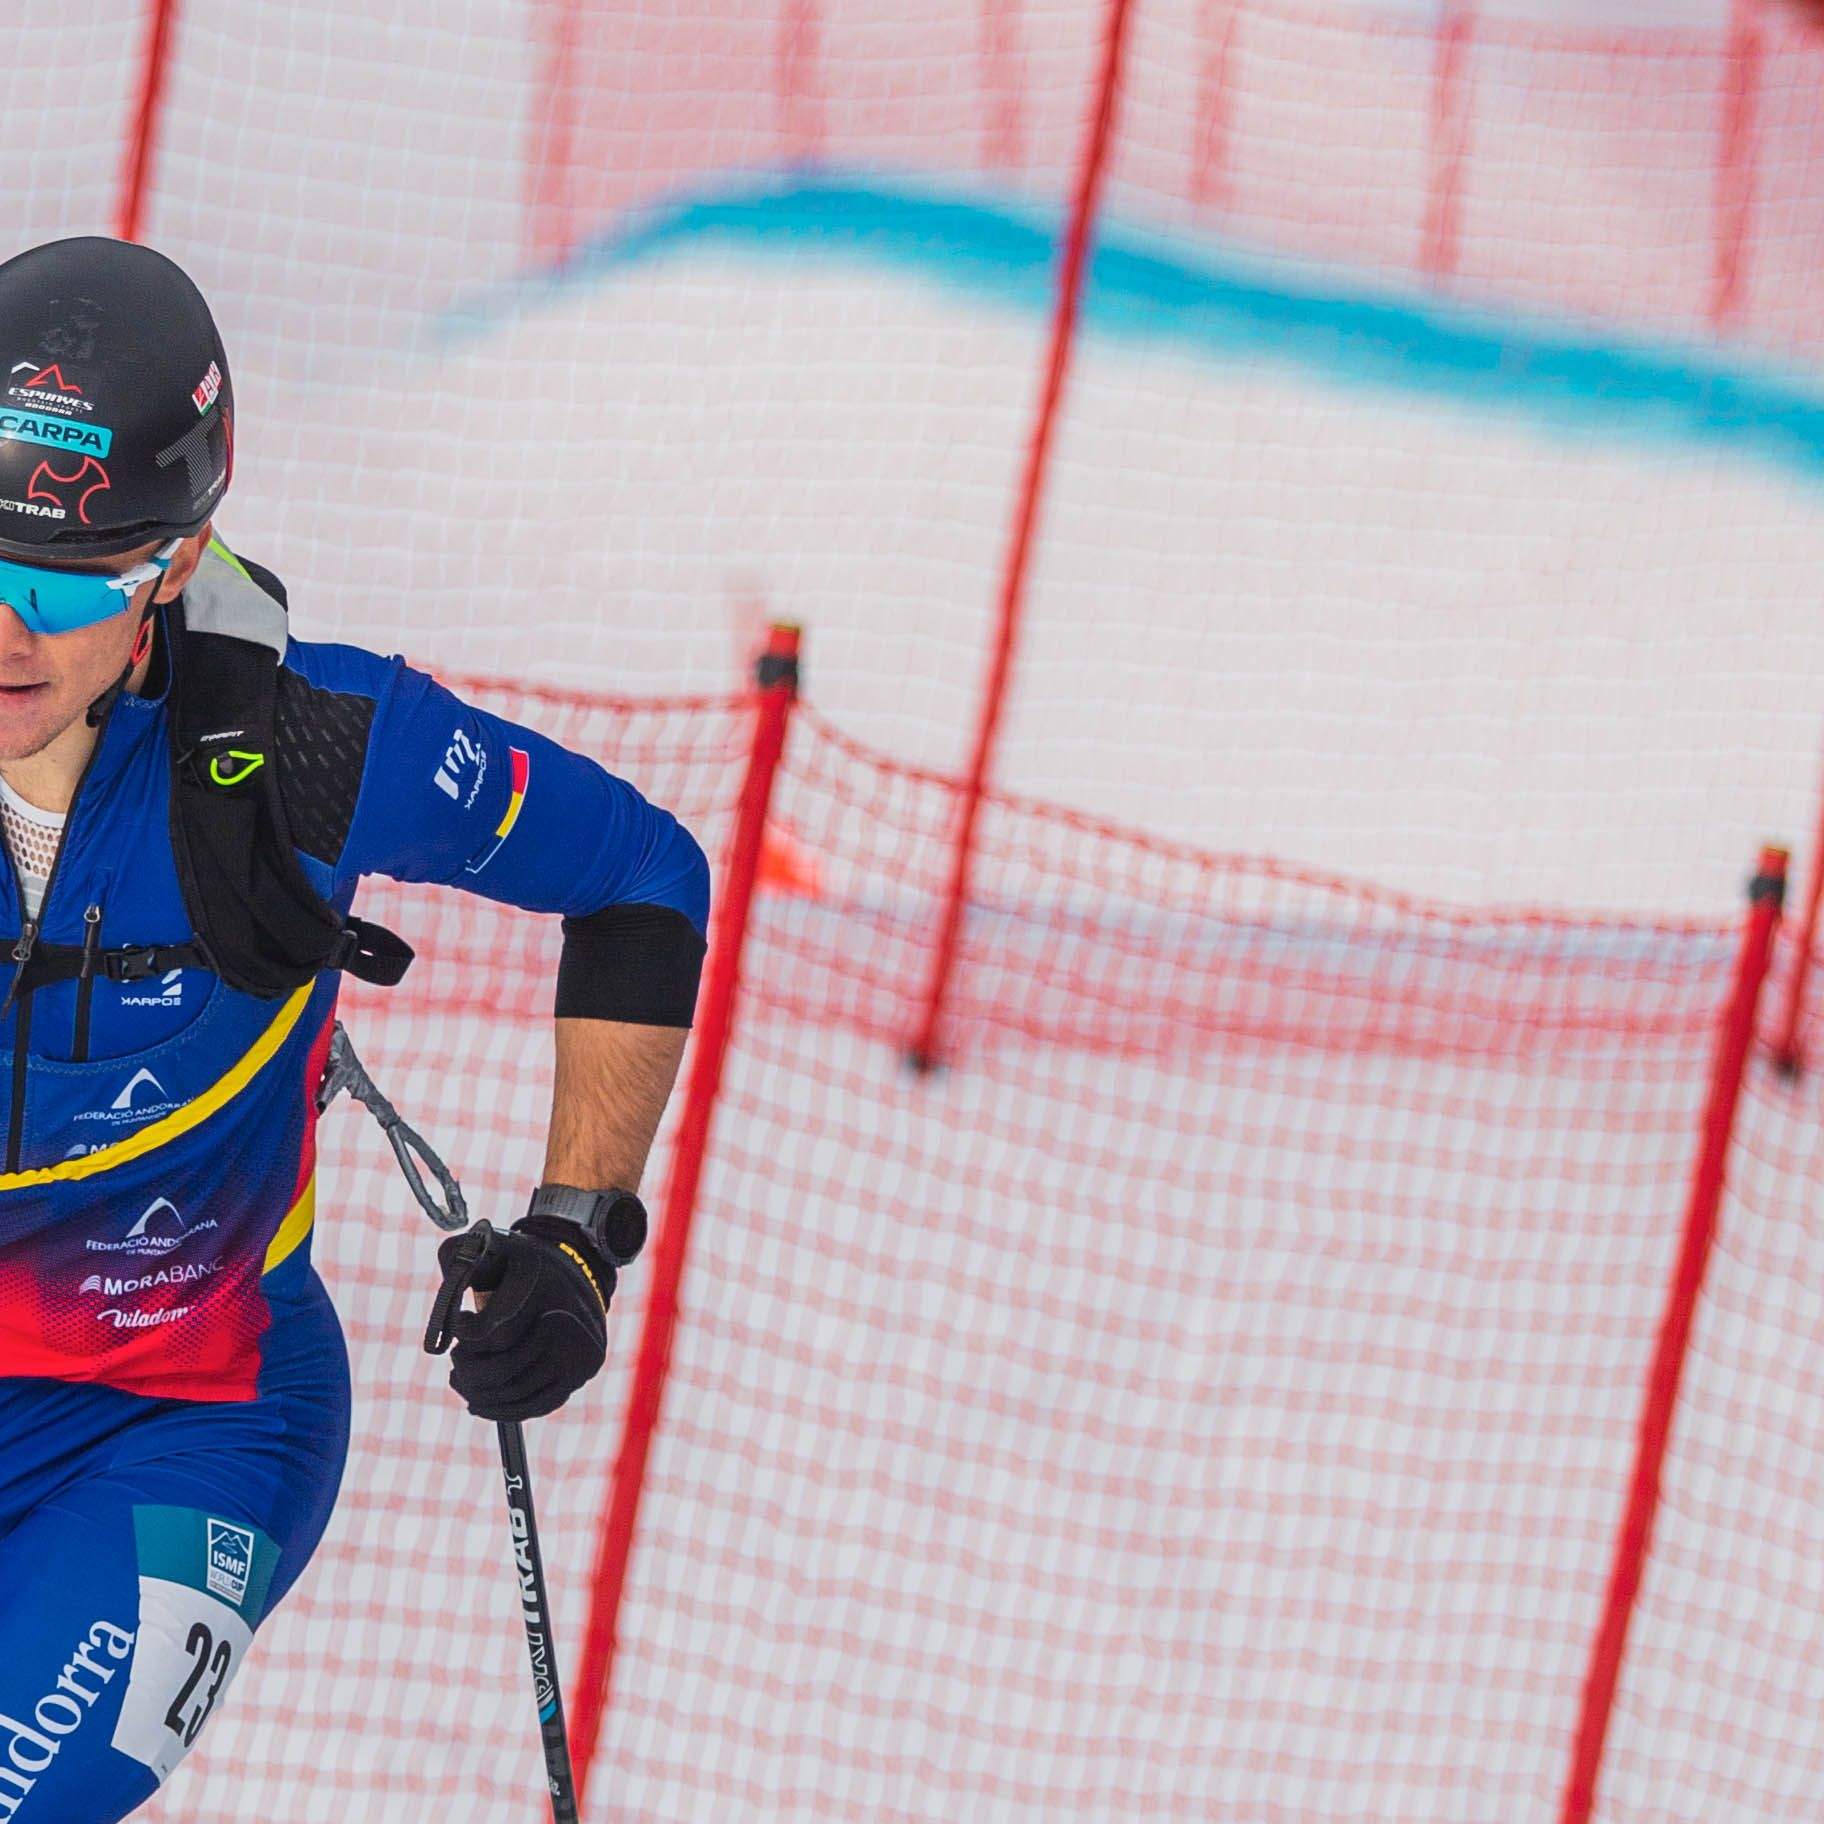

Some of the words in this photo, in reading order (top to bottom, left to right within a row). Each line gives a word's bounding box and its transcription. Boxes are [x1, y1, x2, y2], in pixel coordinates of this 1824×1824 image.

[120, 996, 181, 1006] KARPOS
[104, 1256, 224, 1295] MORABANC
[213, 1550, 246, 1576] ISMF
[164, 1622, 231, 1747] 23
